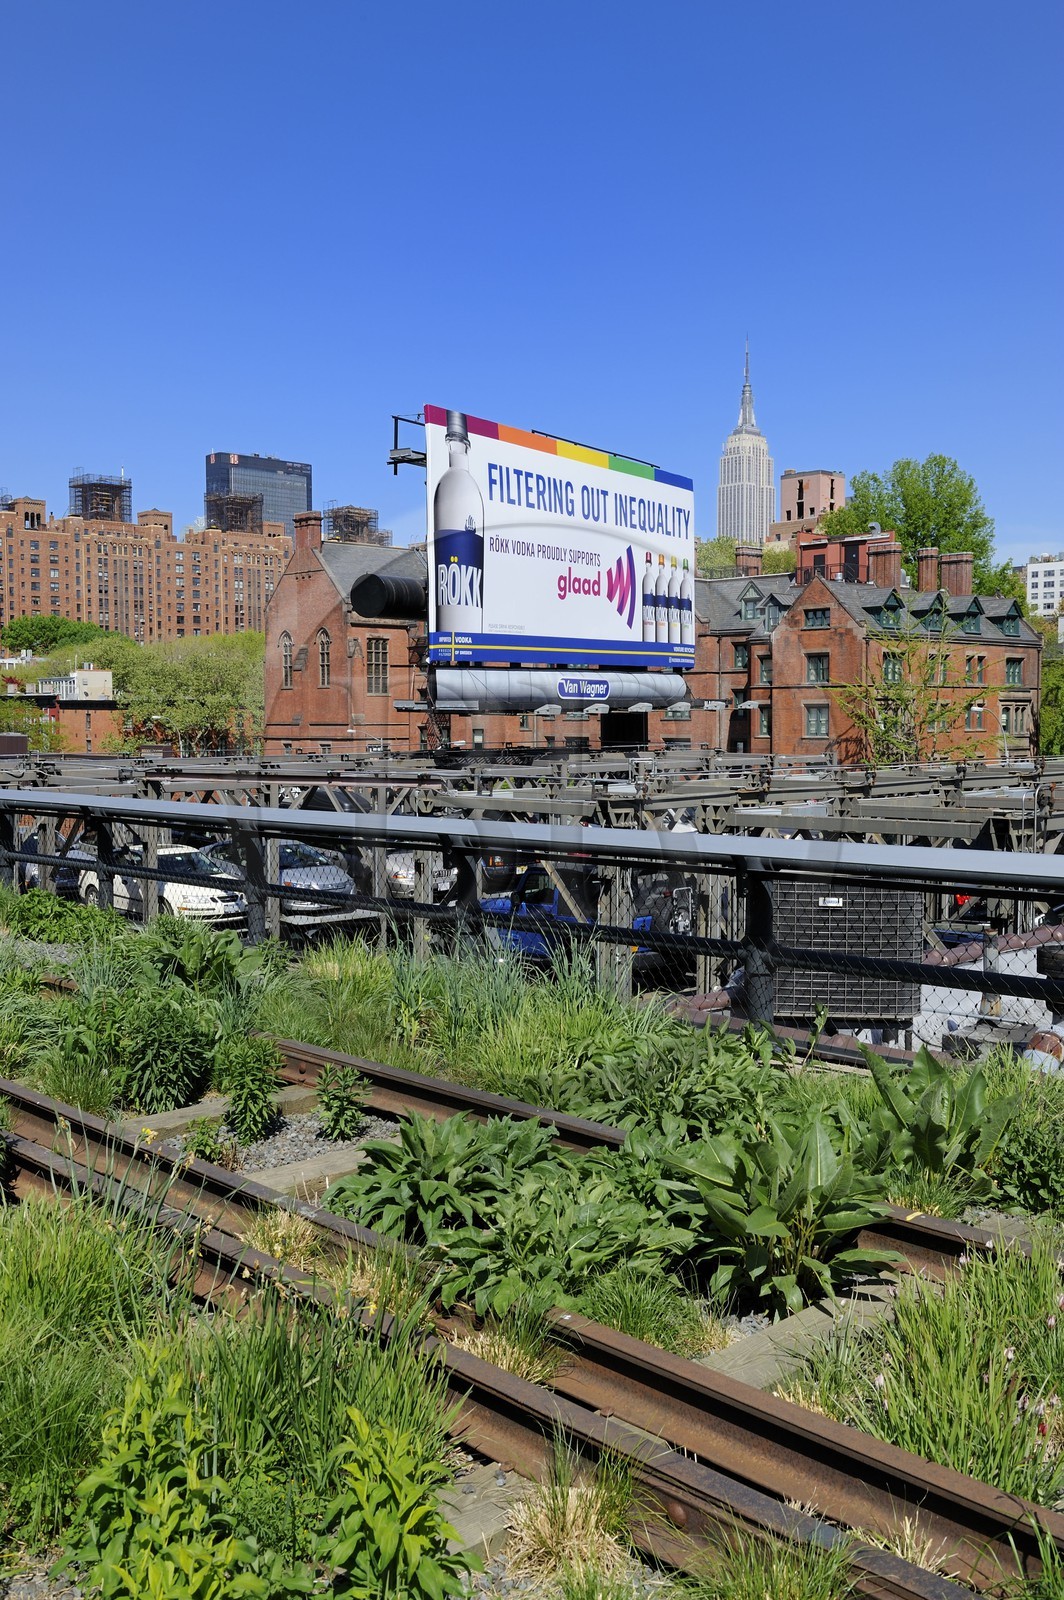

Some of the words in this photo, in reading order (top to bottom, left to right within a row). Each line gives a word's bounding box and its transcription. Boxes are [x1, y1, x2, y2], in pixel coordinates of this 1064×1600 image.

[488, 463, 574, 517] FILTERING
[581, 485, 608, 523] OUT
[614, 493, 690, 539] INEQUALITY
[489, 535, 509, 553] RÖKK
[512, 540, 535, 557] VODKA
[537, 544, 567, 561] PROUDLY
[568, 549, 600, 567] SUPPORTS
[438, 556, 482, 608] RÖKK
[558, 566, 600, 600] glaad
[562, 680, 578, 694] Van
[580, 681, 607, 697] Wagner
